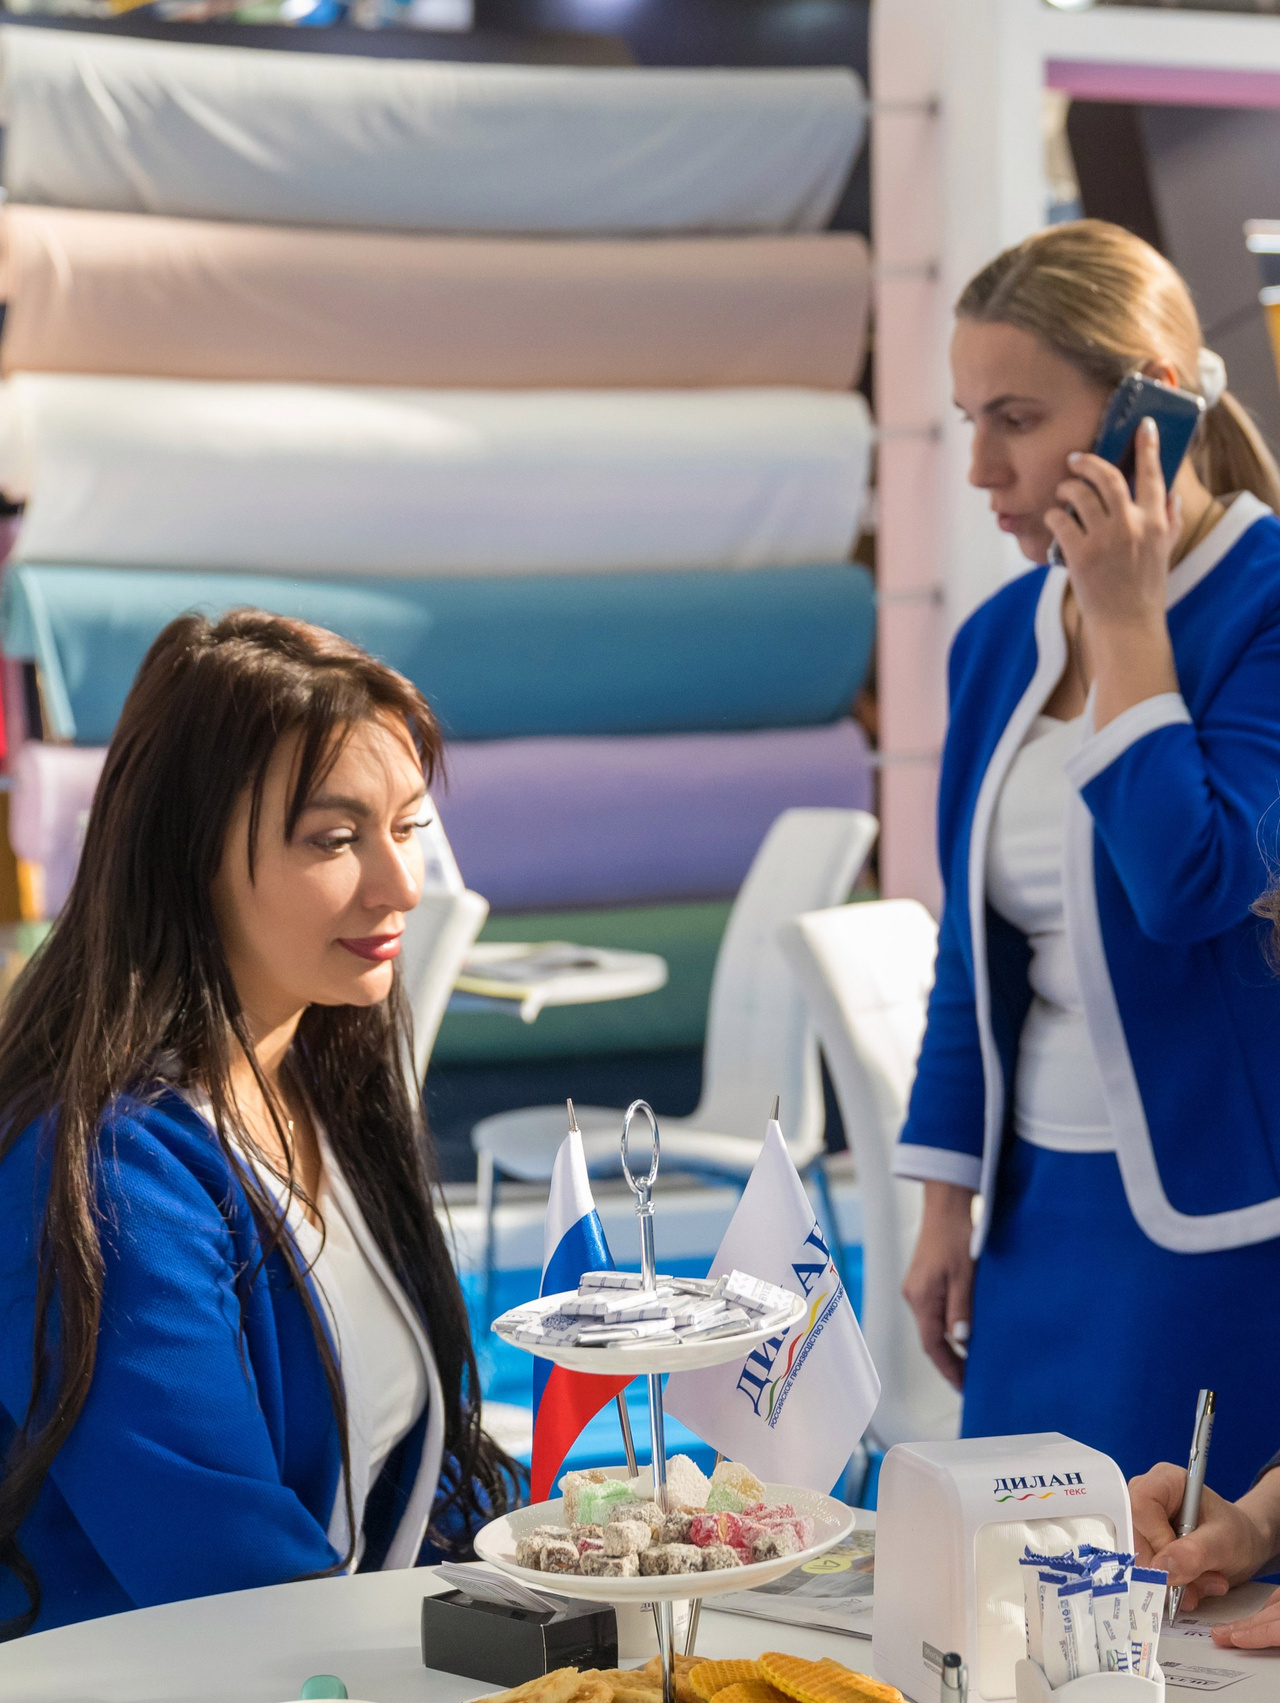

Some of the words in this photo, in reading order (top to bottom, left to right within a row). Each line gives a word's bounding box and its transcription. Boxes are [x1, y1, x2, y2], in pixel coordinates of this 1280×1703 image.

[736, 1220, 830, 1417] ДИАН
[770, 1380, 794, 1429] РОССИЙСКОЕ
[790, 1324, 824, 1381] ПРОИЗВОДСТВО
[993, 1472, 1085, 1494] ДИЛАН
[1064, 1487, 1087, 1496] текс
